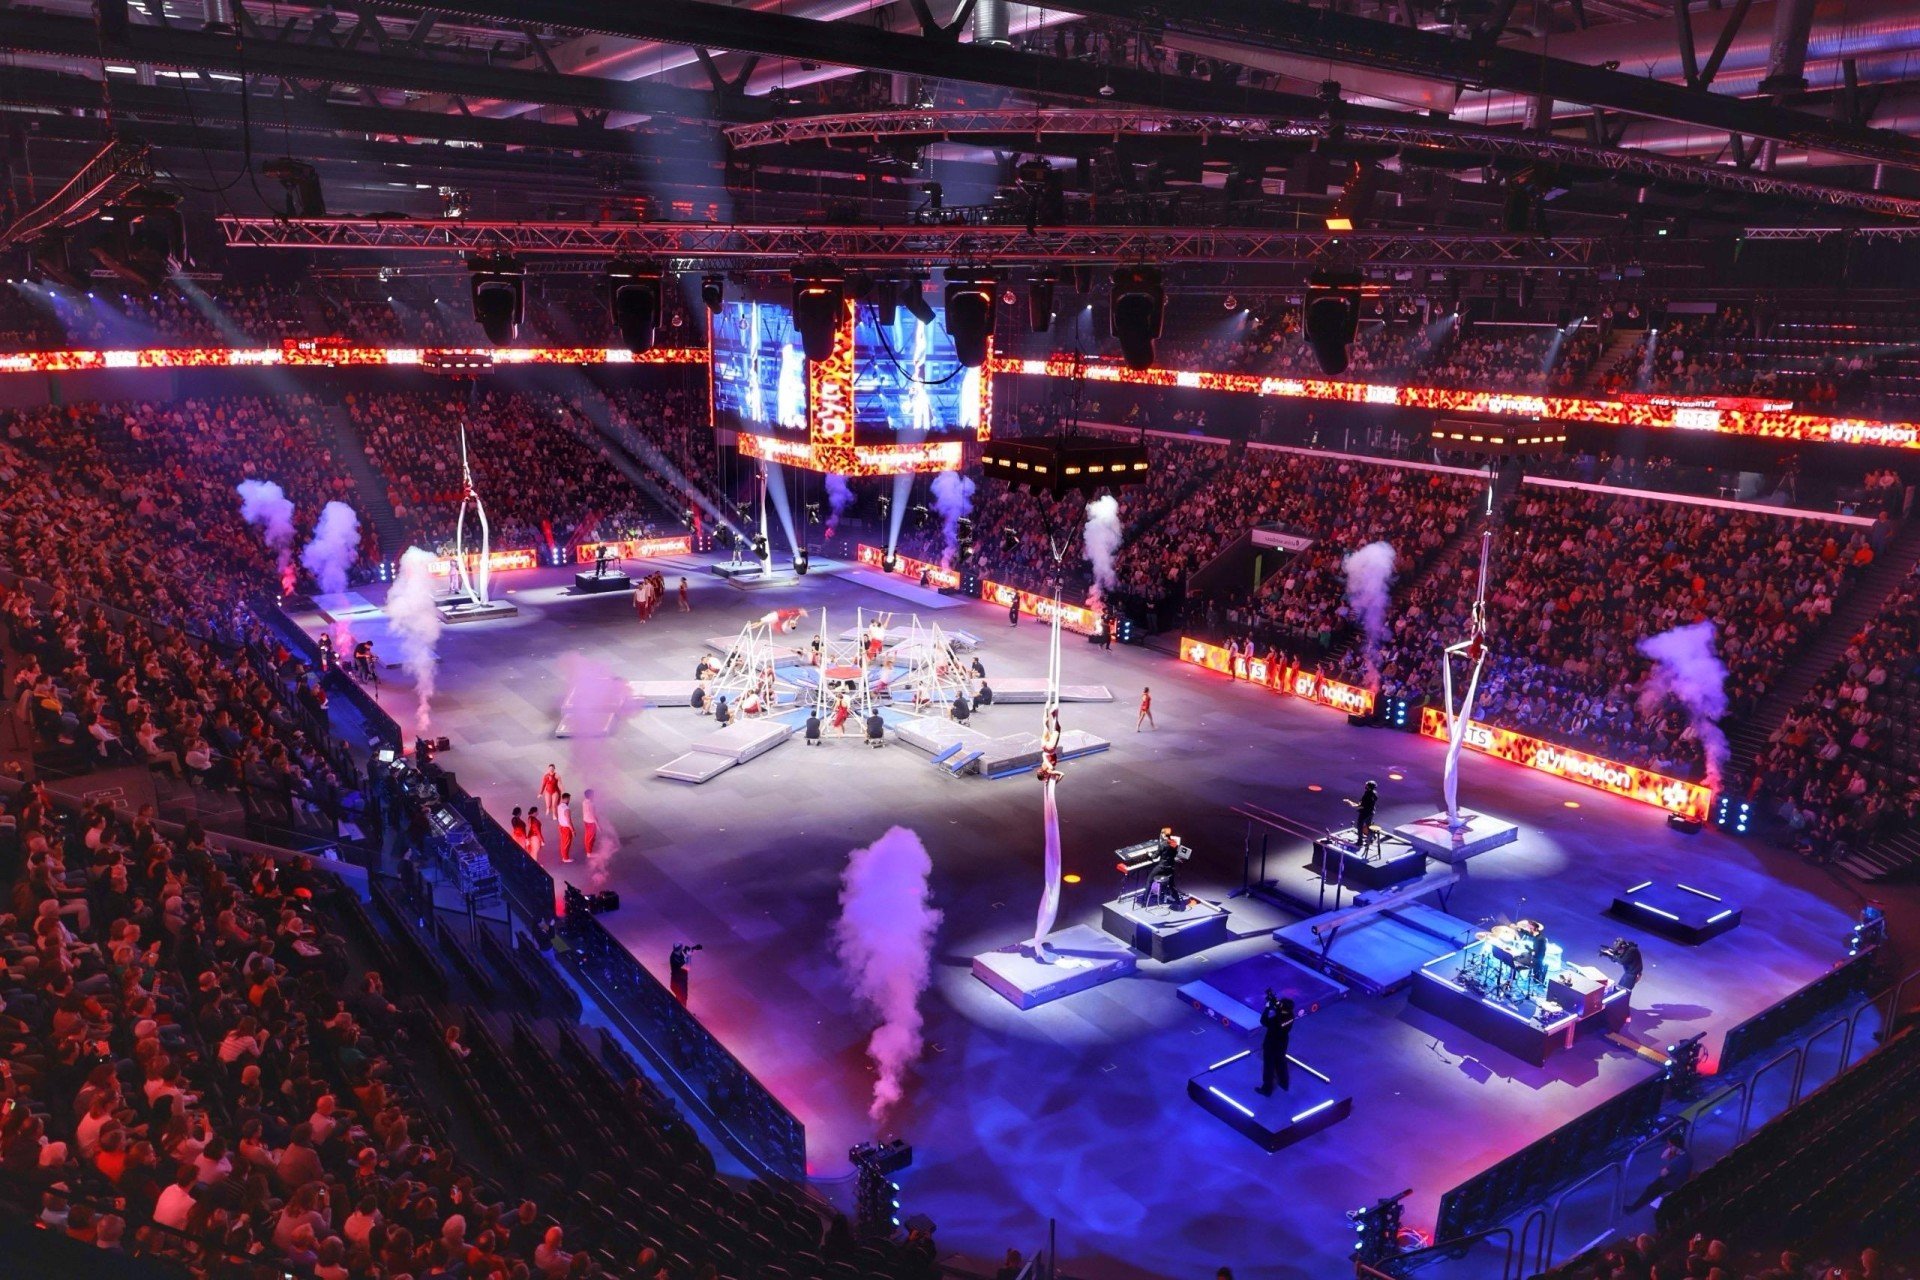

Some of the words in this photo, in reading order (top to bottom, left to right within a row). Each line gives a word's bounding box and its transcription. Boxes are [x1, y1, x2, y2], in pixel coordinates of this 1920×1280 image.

[1830, 420, 1918, 442] gymotion
[1462, 727, 1487, 745] TS
[1536, 747, 1631, 789] gymotion
